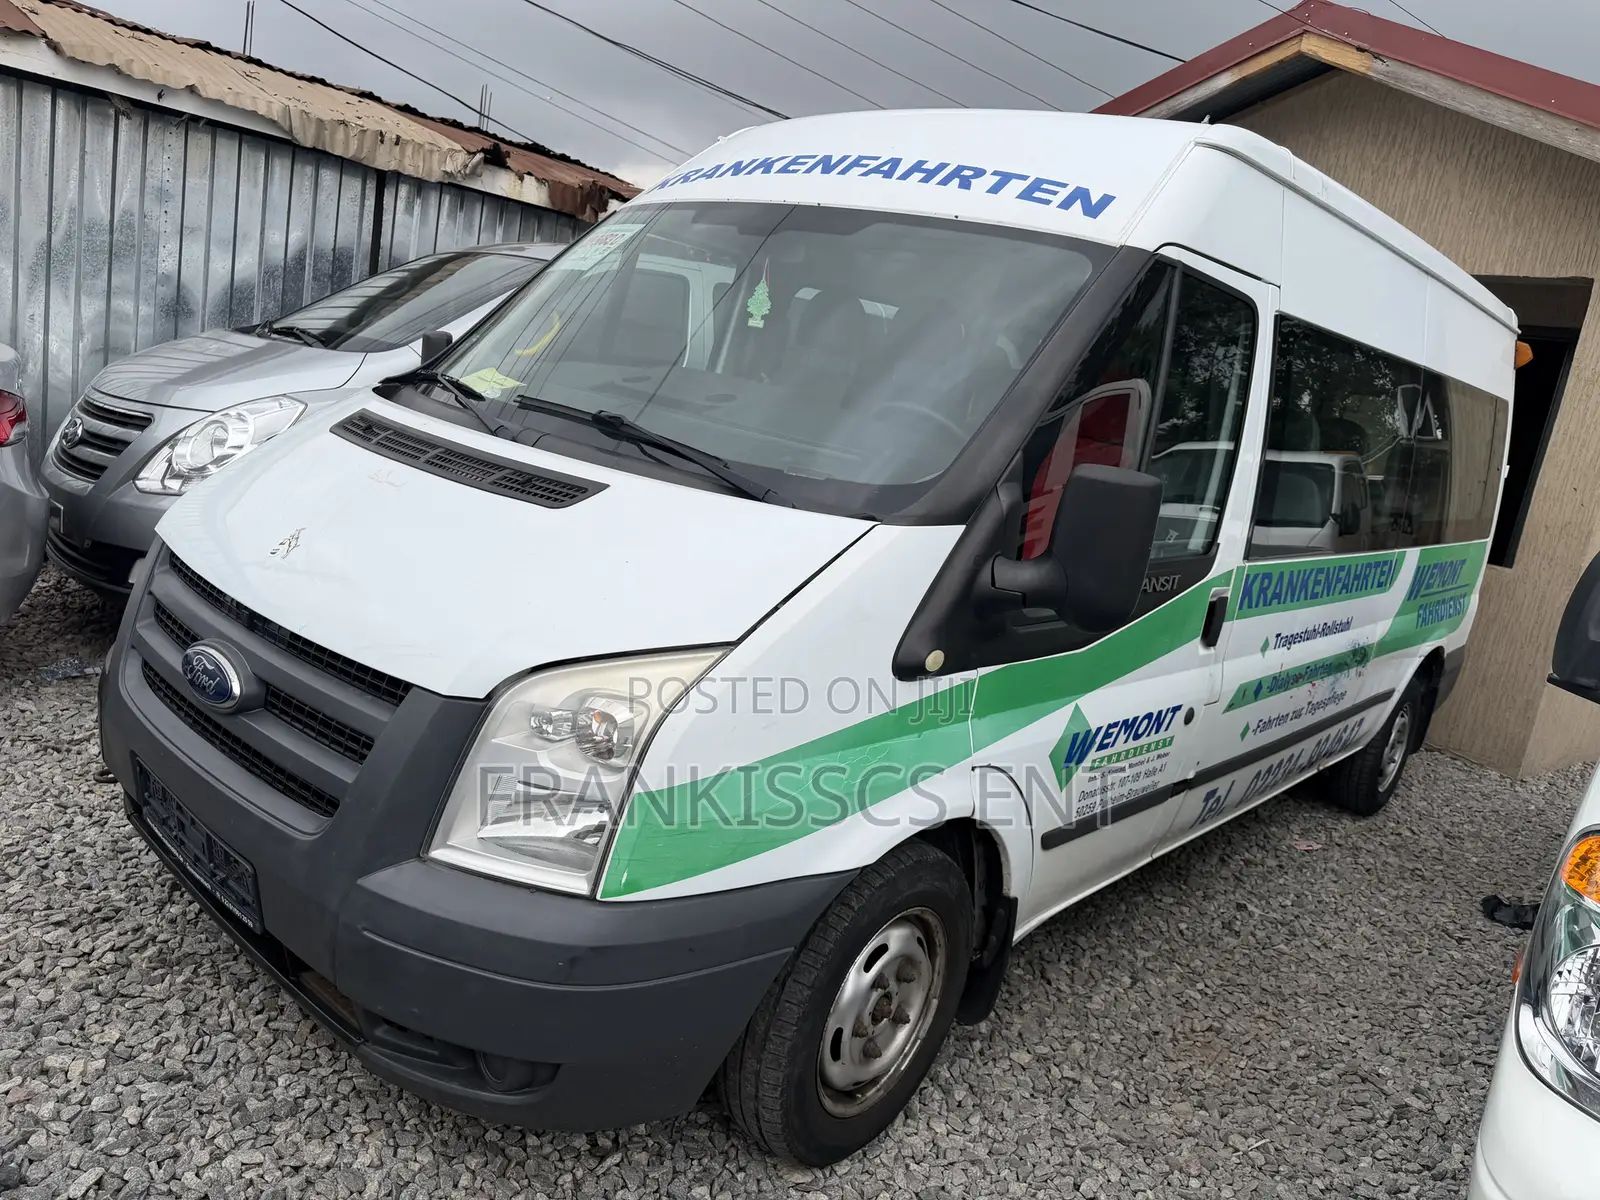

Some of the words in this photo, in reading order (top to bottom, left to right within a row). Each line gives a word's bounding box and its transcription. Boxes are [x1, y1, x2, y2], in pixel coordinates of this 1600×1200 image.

[646, 154, 1116, 219] KRANKENFAHRTEN
[1238, 558, 1398, 611] KRANKENFAHRTEN
[1406, 558, 1467, 602] WEMONT
[1416, 592, 1467, 630] FAHRDIENST
[1273, 616, 1353, 650] Tragestuhl-Rollstuhl
[187, 655, 220, 695] Ford
[1063, 704, 1184, 769] WEMONT
[1093, 737, 1172, 768] FAHRDIENST
